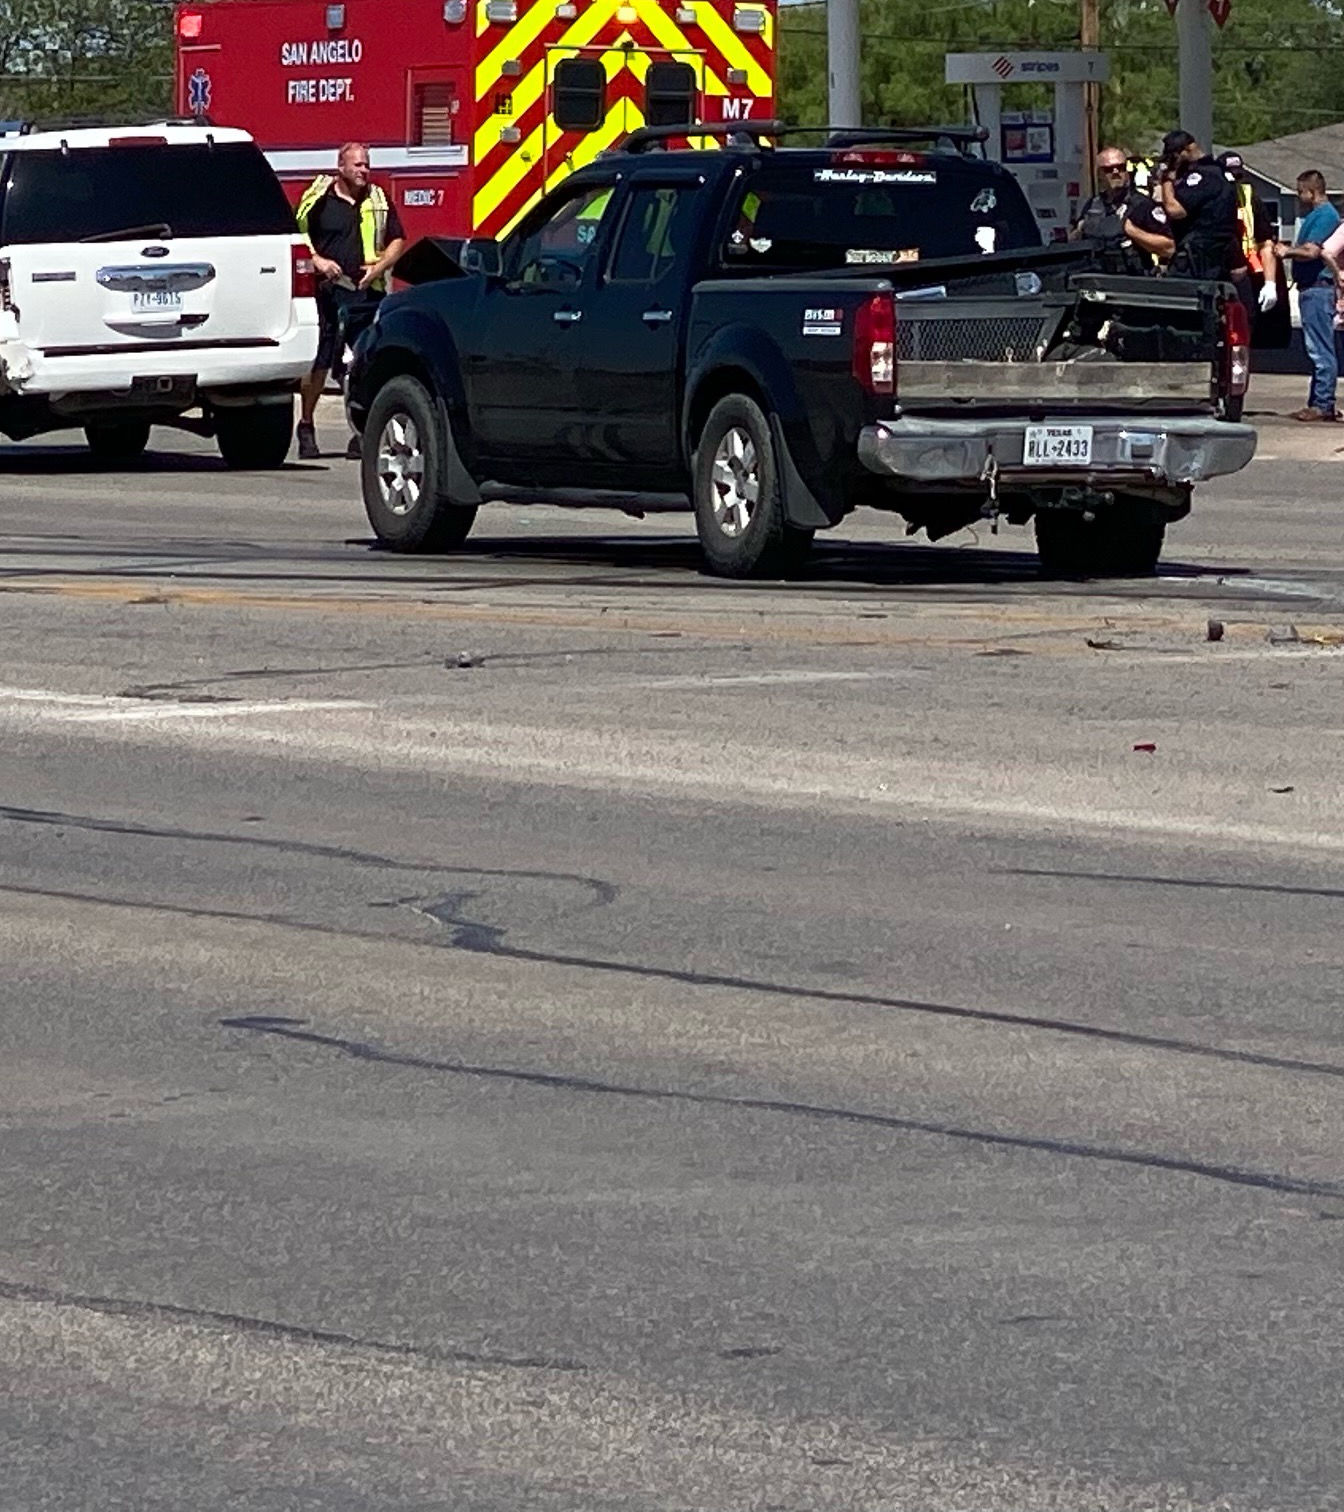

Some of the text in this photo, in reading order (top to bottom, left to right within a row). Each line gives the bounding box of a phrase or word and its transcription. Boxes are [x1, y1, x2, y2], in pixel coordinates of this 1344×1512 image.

[281, 38, 362, 66] SAN ANGELO
[287, 77, 355, 104] FIRE DEPT.
[722, 97, 754, 120] M7
